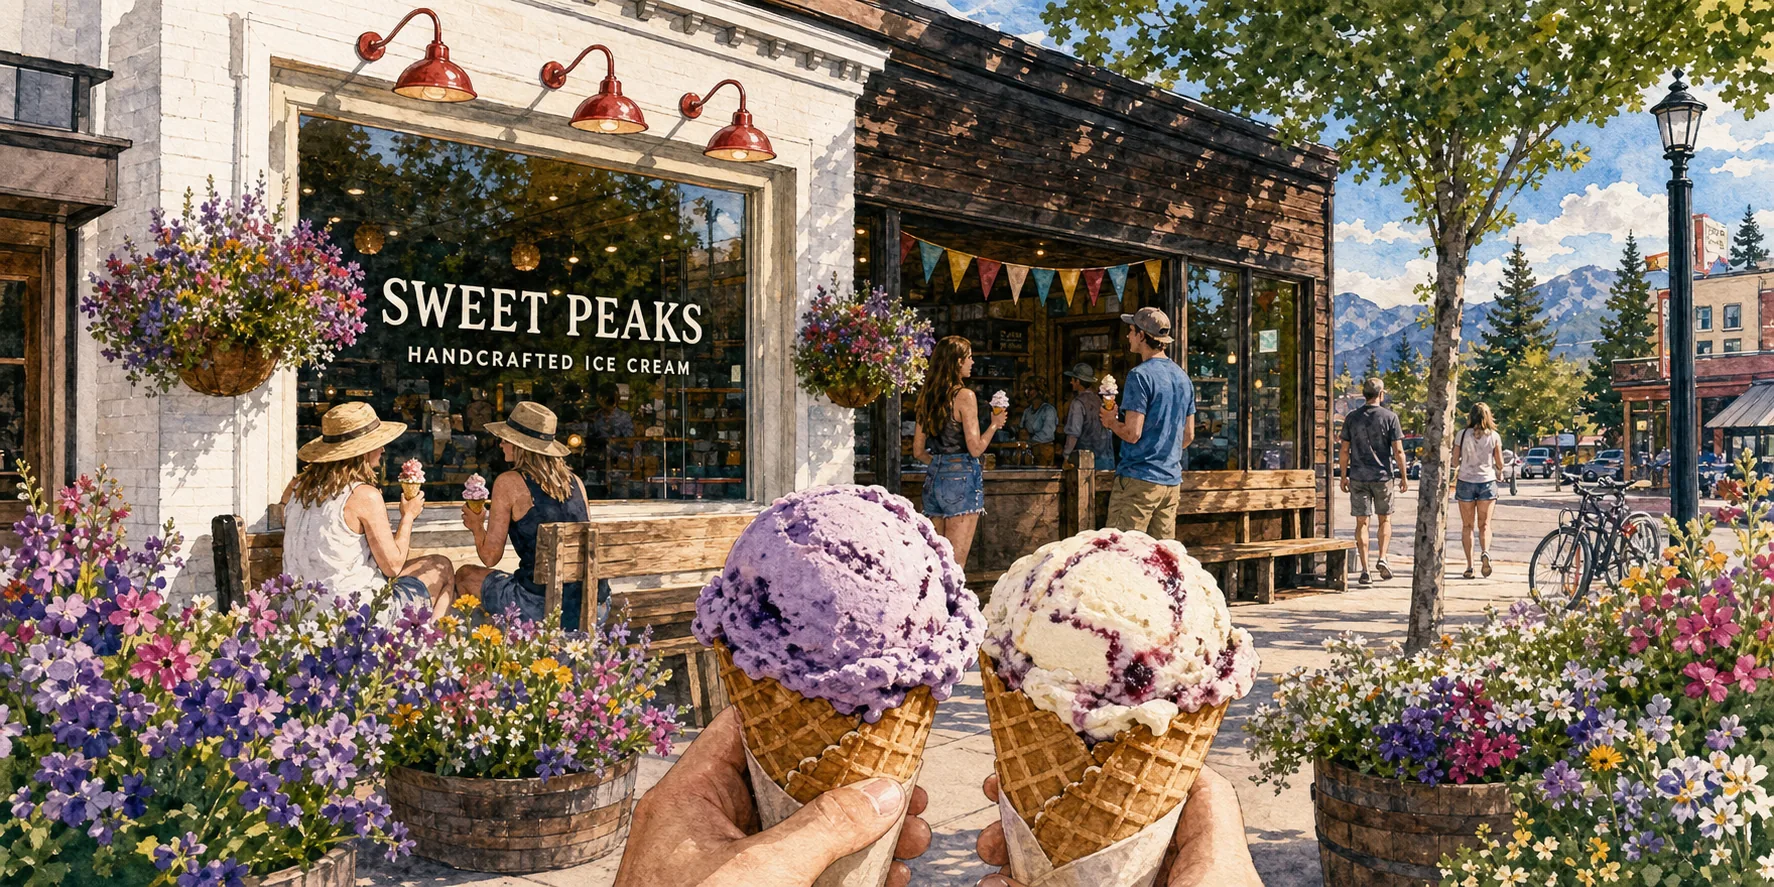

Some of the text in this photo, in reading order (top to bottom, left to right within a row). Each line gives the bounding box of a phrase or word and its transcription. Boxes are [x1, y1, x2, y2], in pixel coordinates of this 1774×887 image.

[382, 277, 703, 345] SWEET PEAKS
[408, 346, 690, 376] HANDCRAFTED ICE CREAM
